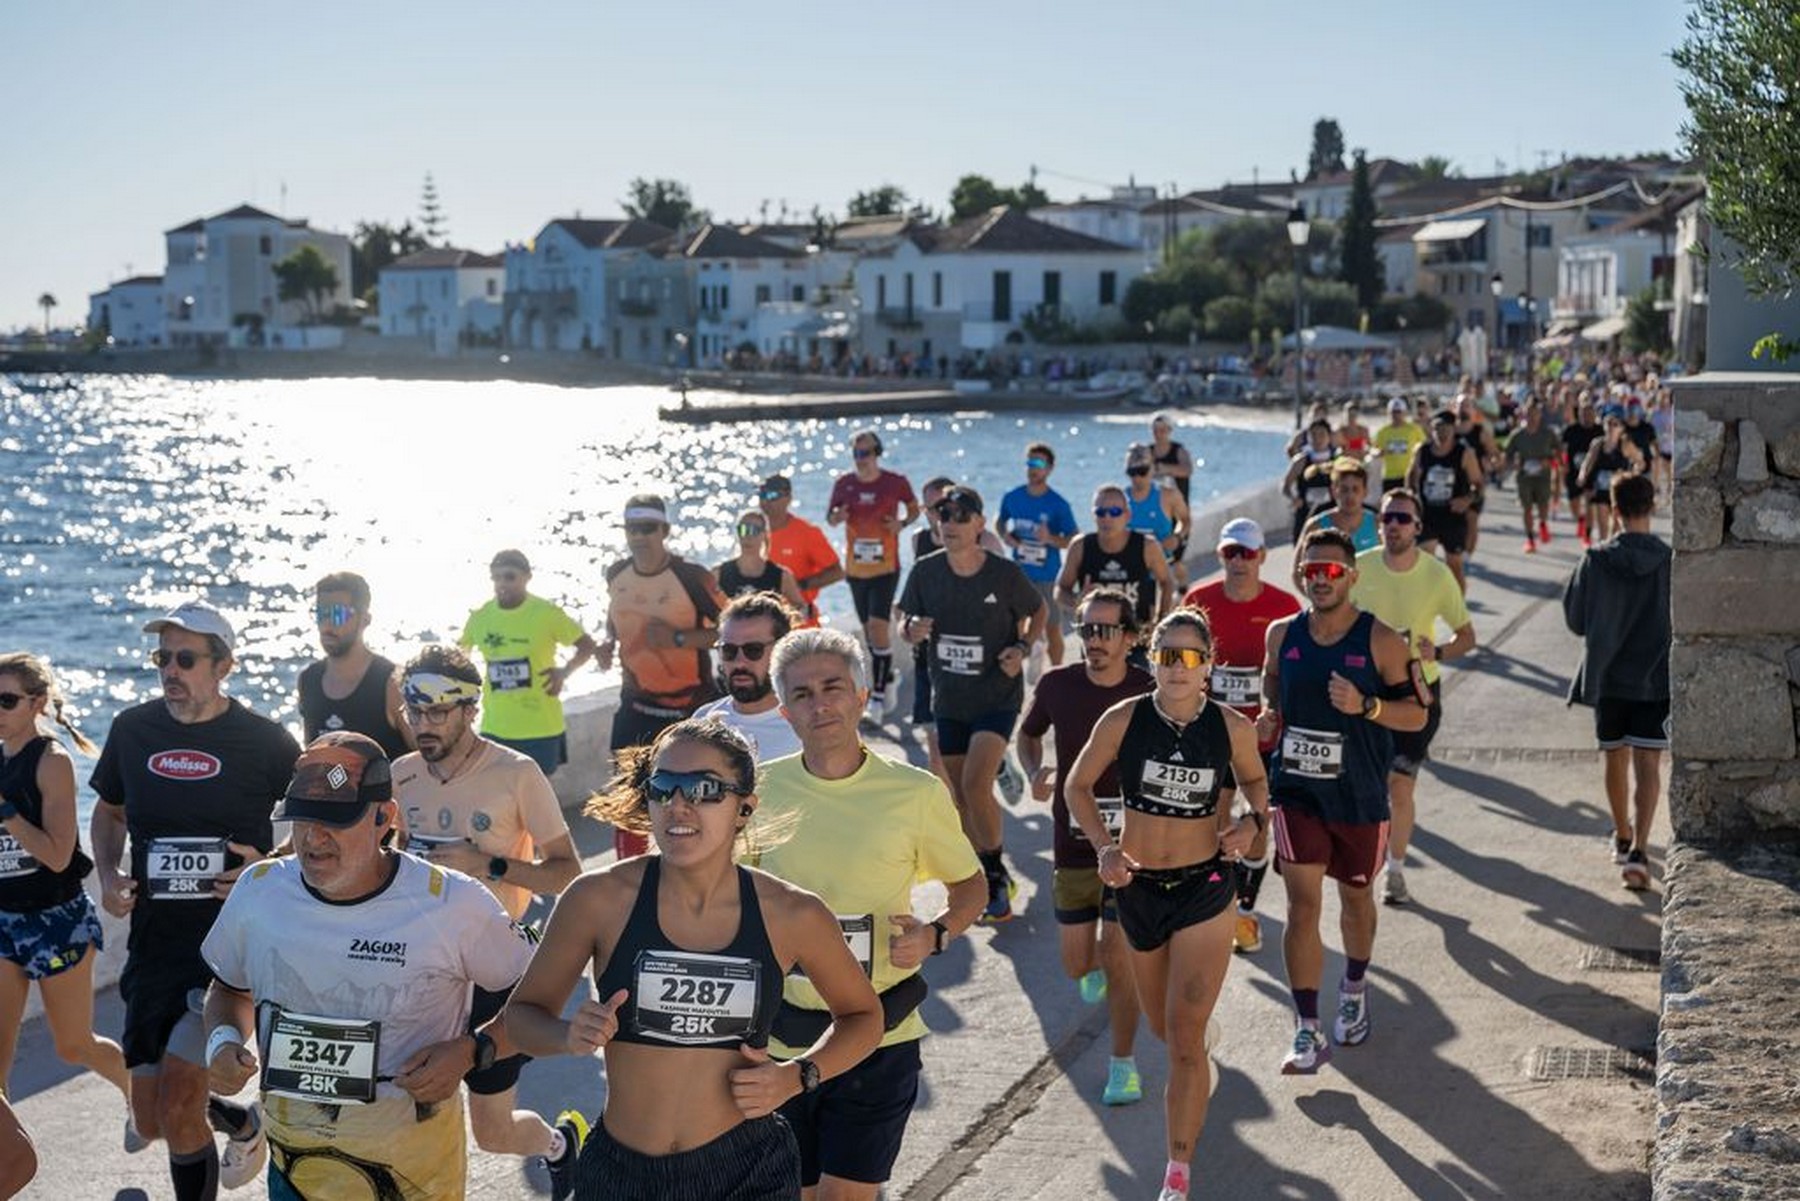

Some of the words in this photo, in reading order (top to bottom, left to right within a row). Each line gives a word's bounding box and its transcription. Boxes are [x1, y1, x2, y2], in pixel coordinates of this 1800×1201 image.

[1292, 741, 1331, 758] 2360
[159, 756, 210, 772] Melissa
[1156, 765, 1200, 785] 2130
[1161, 787, 1190, 803] 25K
[160, 855, 209, 871] 2100
[168, 879, 199, 892] 25K
[660, 977, 735, 1006] 2287
[671, 1015, 716, 1034] 25K
[289, 1038, 355, 1067] 2347
[298, 1073, 338, 1095] 25K
